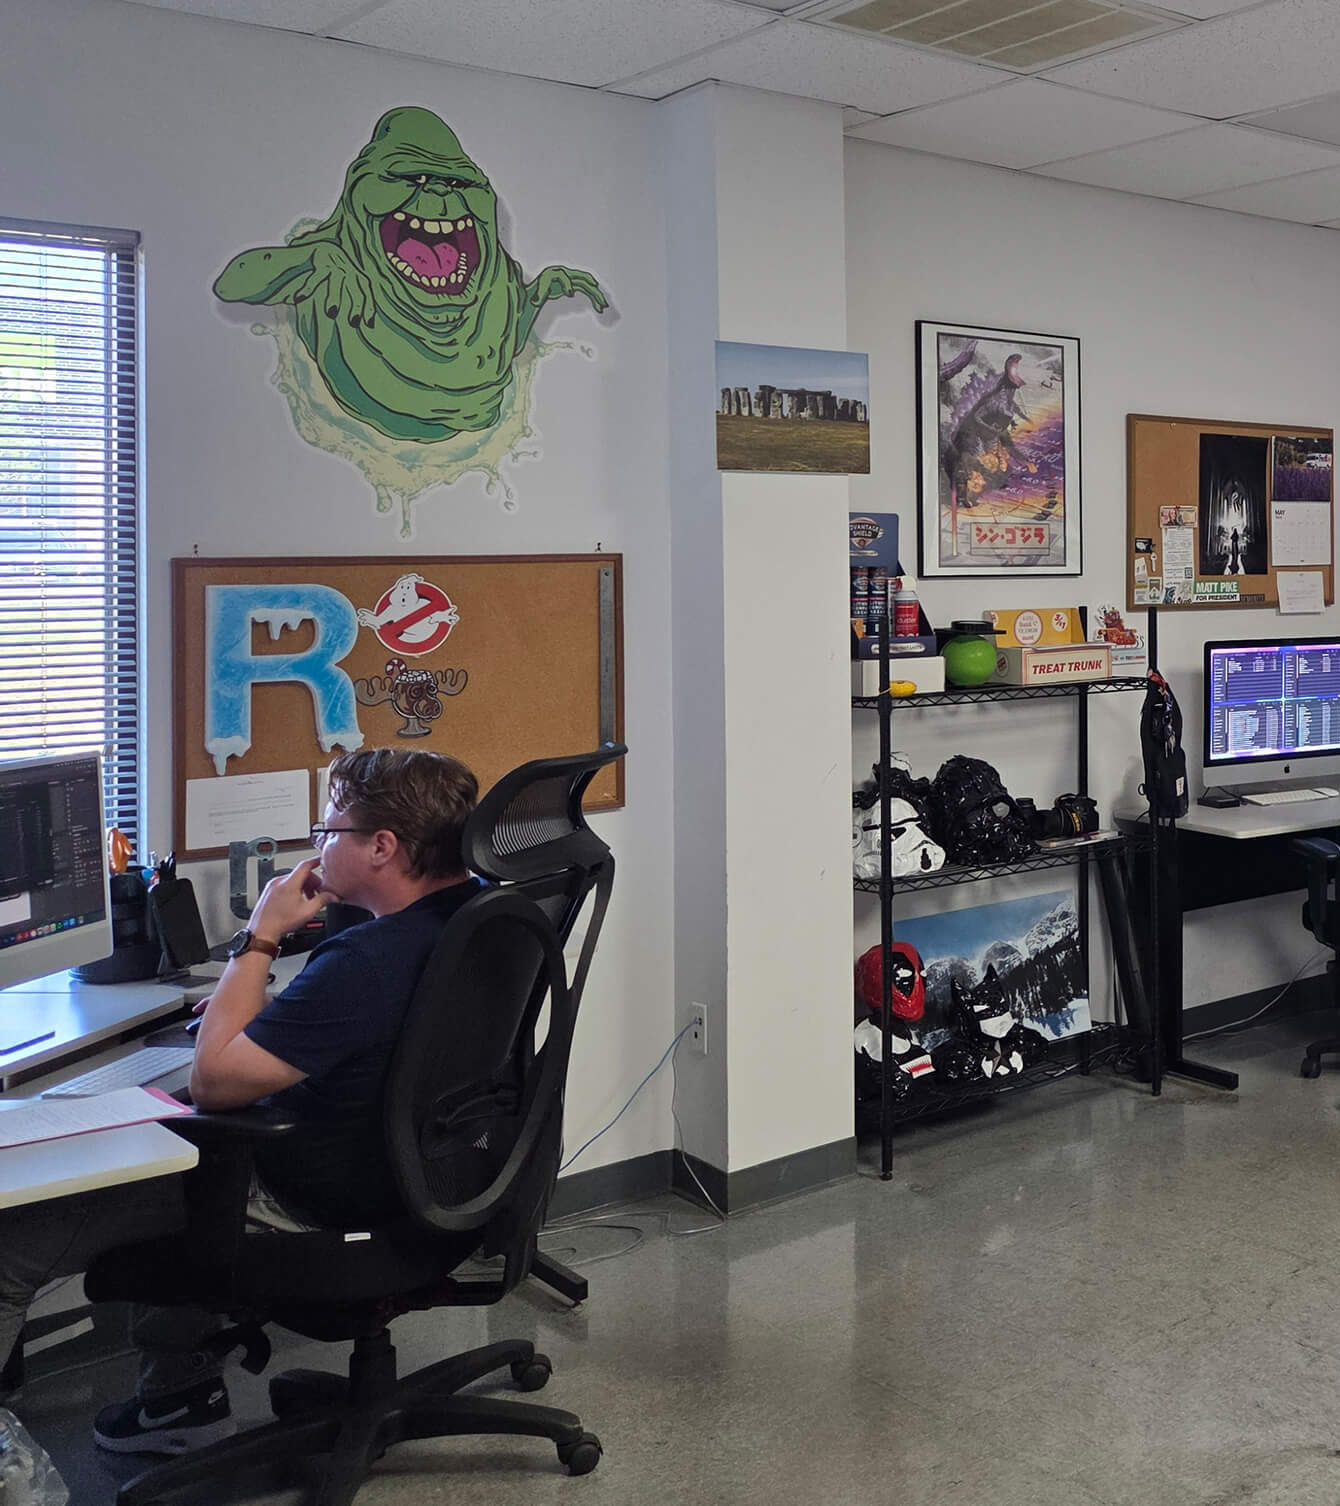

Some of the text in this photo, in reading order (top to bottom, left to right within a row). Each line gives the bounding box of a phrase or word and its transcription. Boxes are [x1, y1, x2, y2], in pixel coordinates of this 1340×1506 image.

[849, 523, 880, 535] DVANTAGE
[1196, 582, 1238, 593] MATT PIKE
[1032, 659, 1102, 675] TREAT TRUNK
